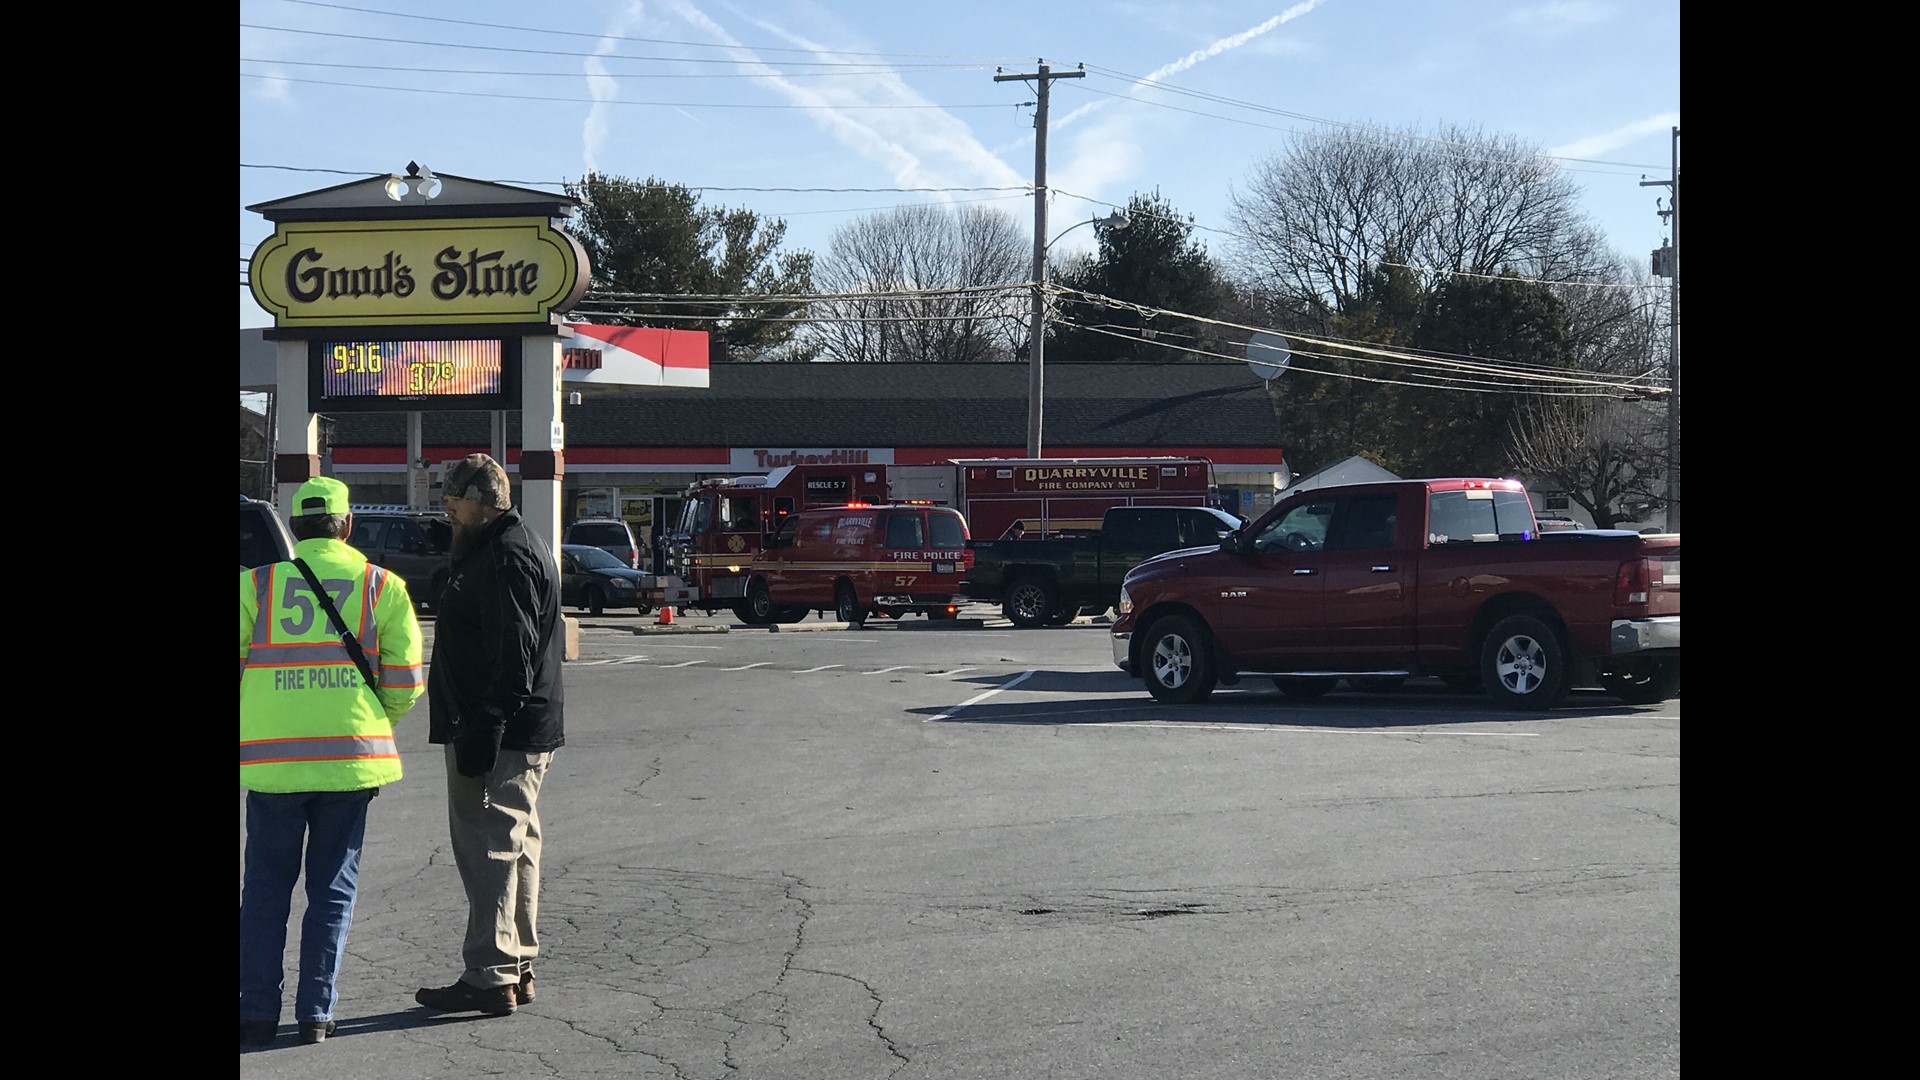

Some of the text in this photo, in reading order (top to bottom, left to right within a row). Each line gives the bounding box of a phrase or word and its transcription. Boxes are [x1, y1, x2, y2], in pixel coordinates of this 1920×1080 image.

[287, 246, 539, 302] Good's Store
[333, 344, 382, 374] 9:16
[1025, 468, 1148, 481] QUARRYVILLE
[807, 481, 832, 489] RESCUE
[1039, 482, 1062, 490] FIRE
[846, 527, 858, 537] 57
[894, 576, 918, 587] 57
[279, 576, 355, 636] 57
[274, 667, 358, 691] FIRE POLICE
